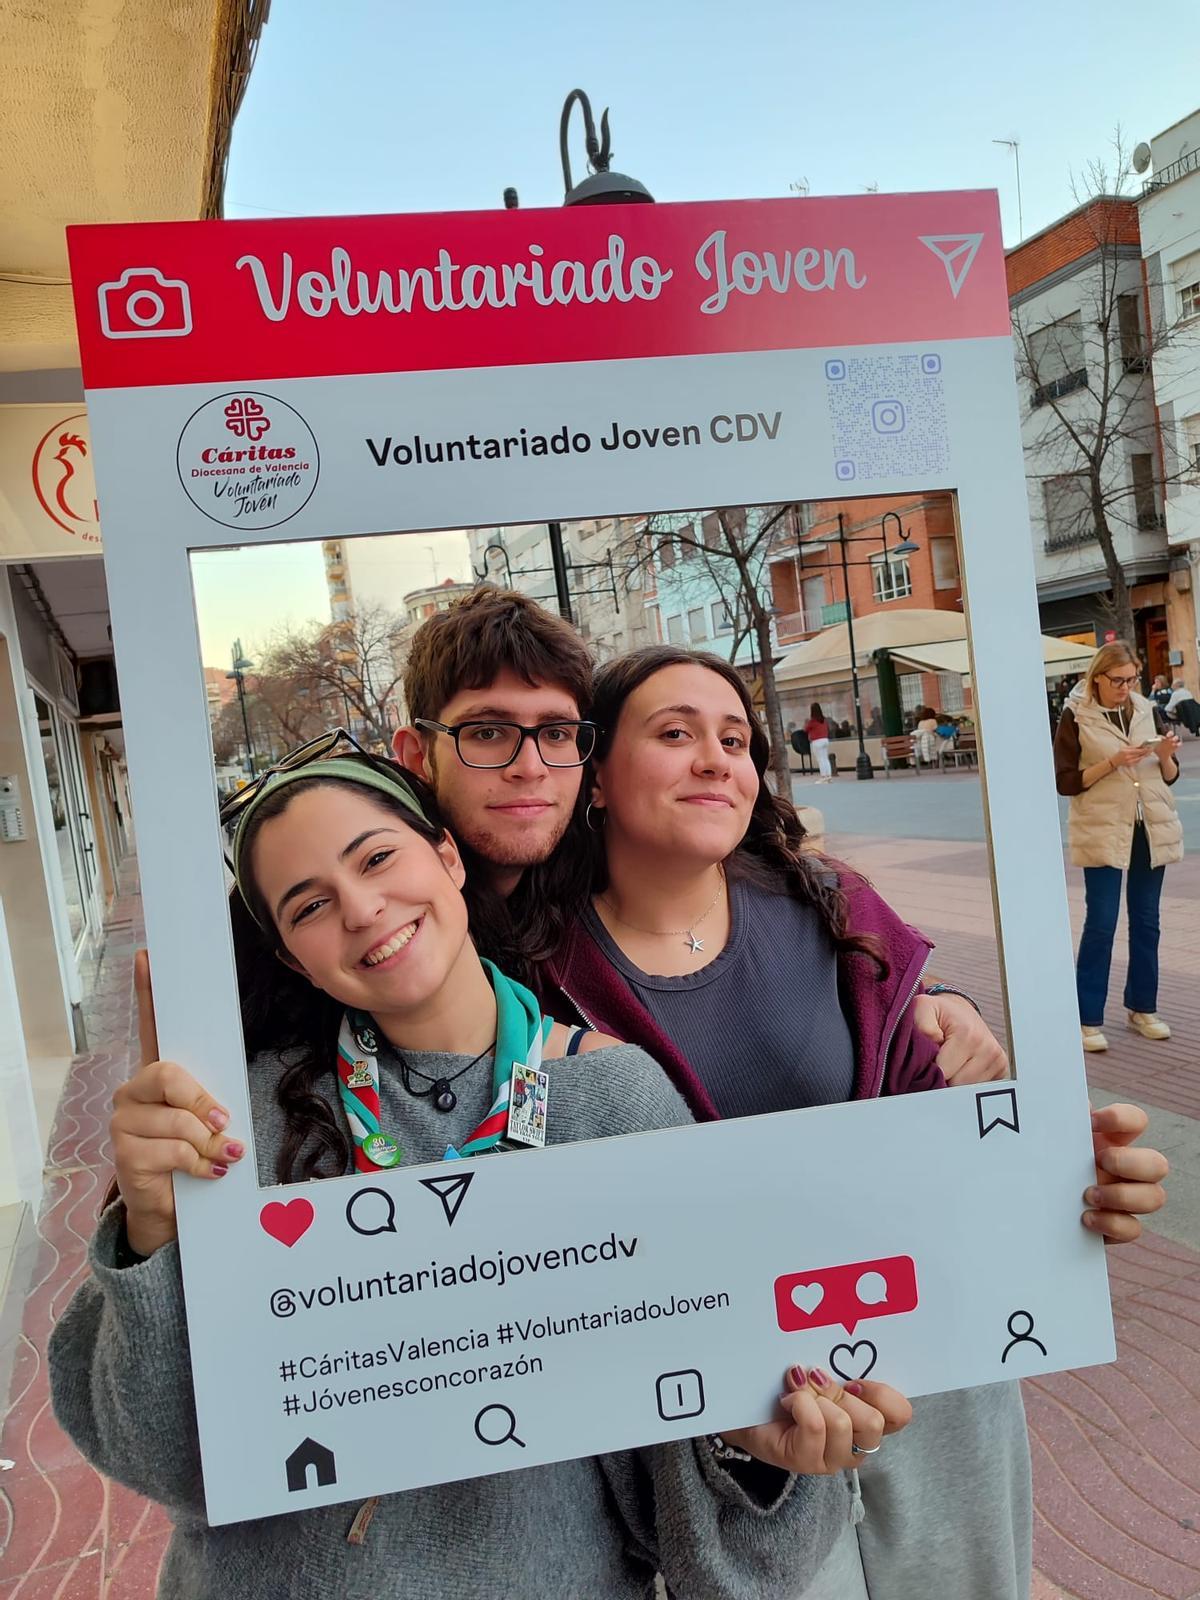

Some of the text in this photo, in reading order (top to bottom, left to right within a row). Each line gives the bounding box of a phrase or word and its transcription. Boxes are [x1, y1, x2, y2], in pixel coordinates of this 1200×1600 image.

[235, 230, 867, 322] Voluntariado Joven
[201, 445, 296, 464] Cáritas
[366, 411, 782, 467] Voluntariado Joven CDV
[191, 461, 310, 478] Diocesana de Valencia
[214, 471, 301, 498] Voluntariado
[232, 493, 278, 518] Joven
[269, 1233, 638, 1318] @voluntariadojovencdv
[279, 1292, 731, 1383] #CáritasValencia #VoluntariadoJoven
[282, 1353, 544, 1417] #Jóvenesconcorazón
